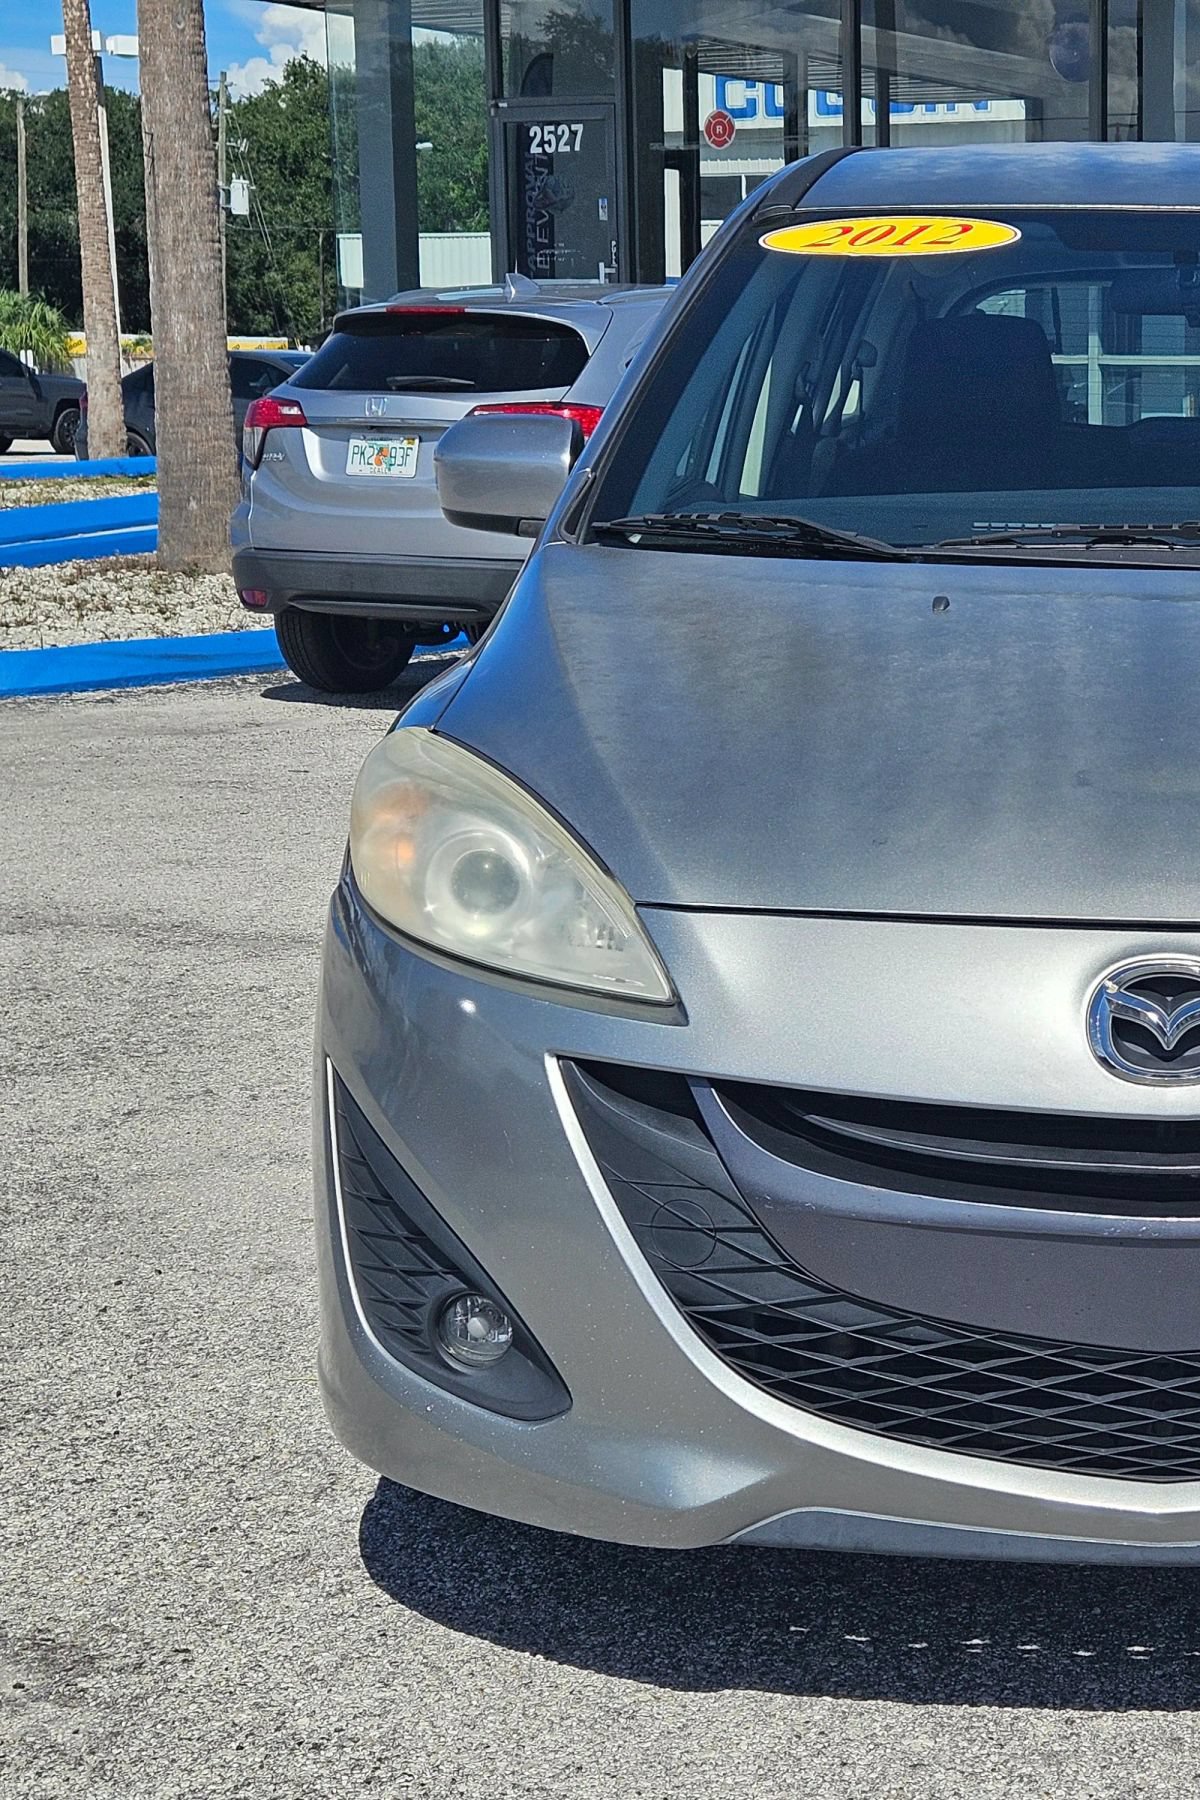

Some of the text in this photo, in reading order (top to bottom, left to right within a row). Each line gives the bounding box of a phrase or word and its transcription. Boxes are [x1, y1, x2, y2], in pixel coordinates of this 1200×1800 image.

[530, 124, 583, 153] 2527
[716, 125, 723, 134] R
[801, 224, 974, 247] 2012
